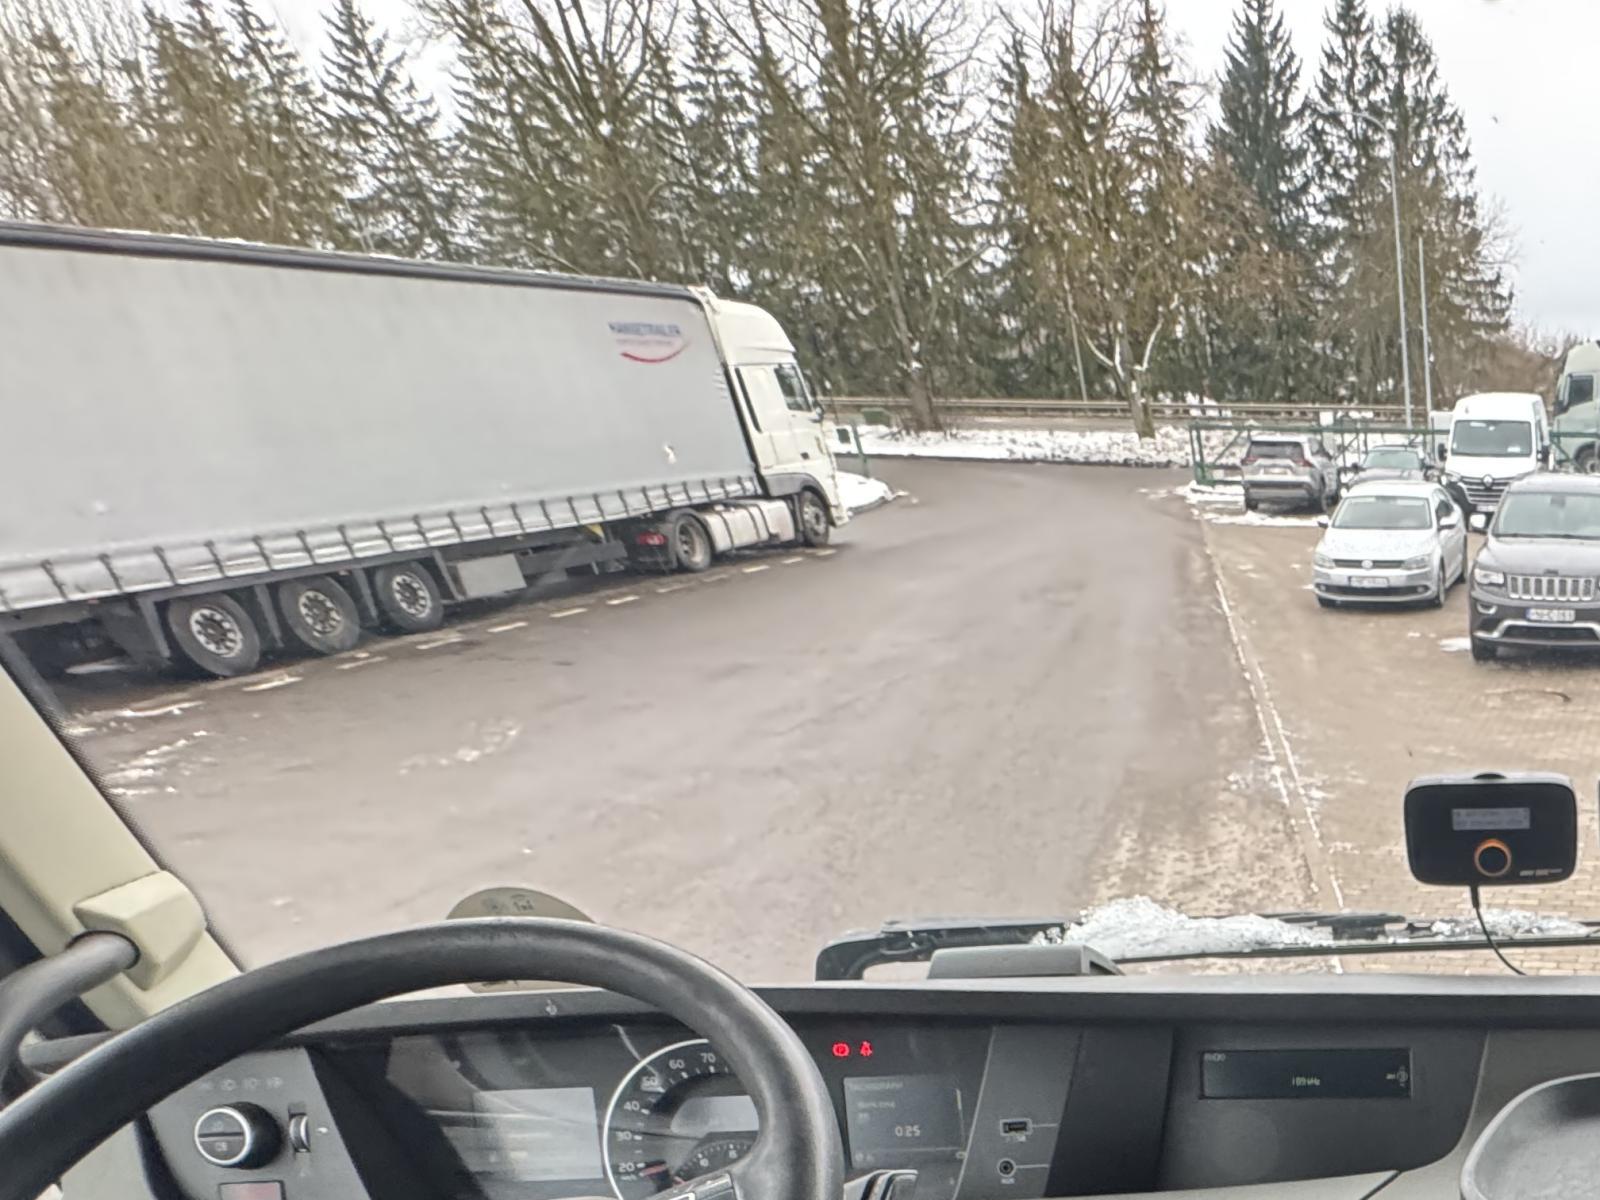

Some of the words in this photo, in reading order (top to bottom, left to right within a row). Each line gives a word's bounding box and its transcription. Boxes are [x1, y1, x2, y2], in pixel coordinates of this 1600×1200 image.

[701, 1053, 716, 1063] 70
[669, 1059, 685, 1069] 60
[642, 1077, 659, 1088] 50
[624, 1101, 640, 1111] 40
[619, 1163, 635, 1172] 20
